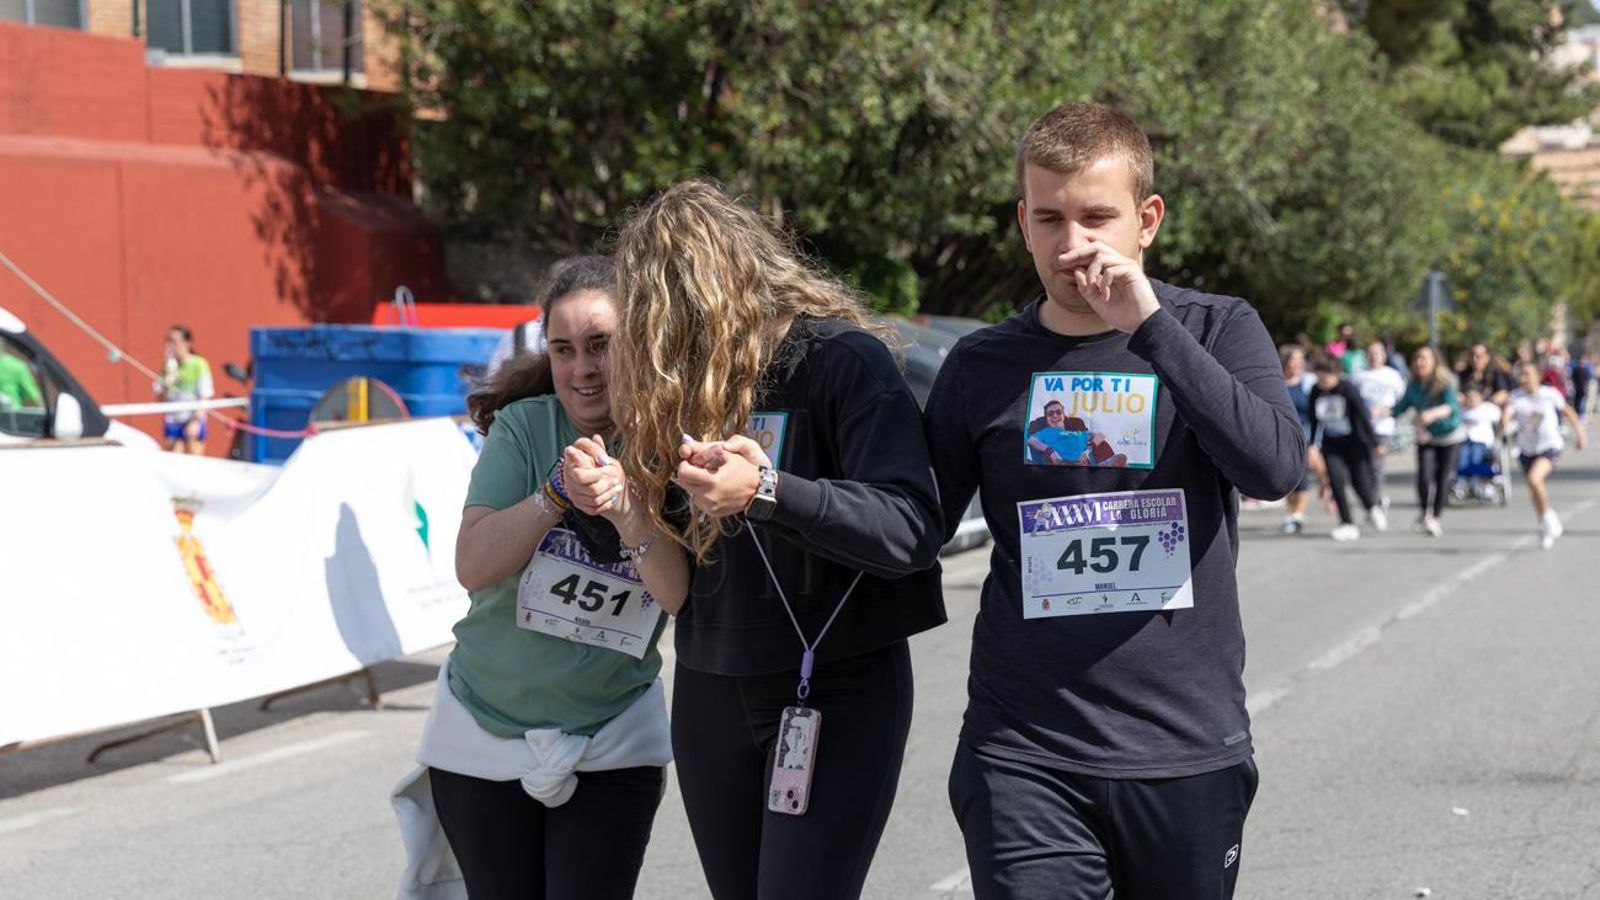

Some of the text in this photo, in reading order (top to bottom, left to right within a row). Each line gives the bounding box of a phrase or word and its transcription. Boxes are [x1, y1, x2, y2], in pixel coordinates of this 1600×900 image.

[1044, 378, 1064, 392] VA
[1071, 377, 1104, 392] POR
[1071, 392, 1146, 418] JULIO
[752, 417, 766, 430] TI
[1050, 496, 1177, 526] XXXVI CARRERA ESCOLAR
[1110, 507, 1167, 521] LA GLORIA
[1056, 535, 1150, 575] 457
[550, 573, 631, 617] 451
